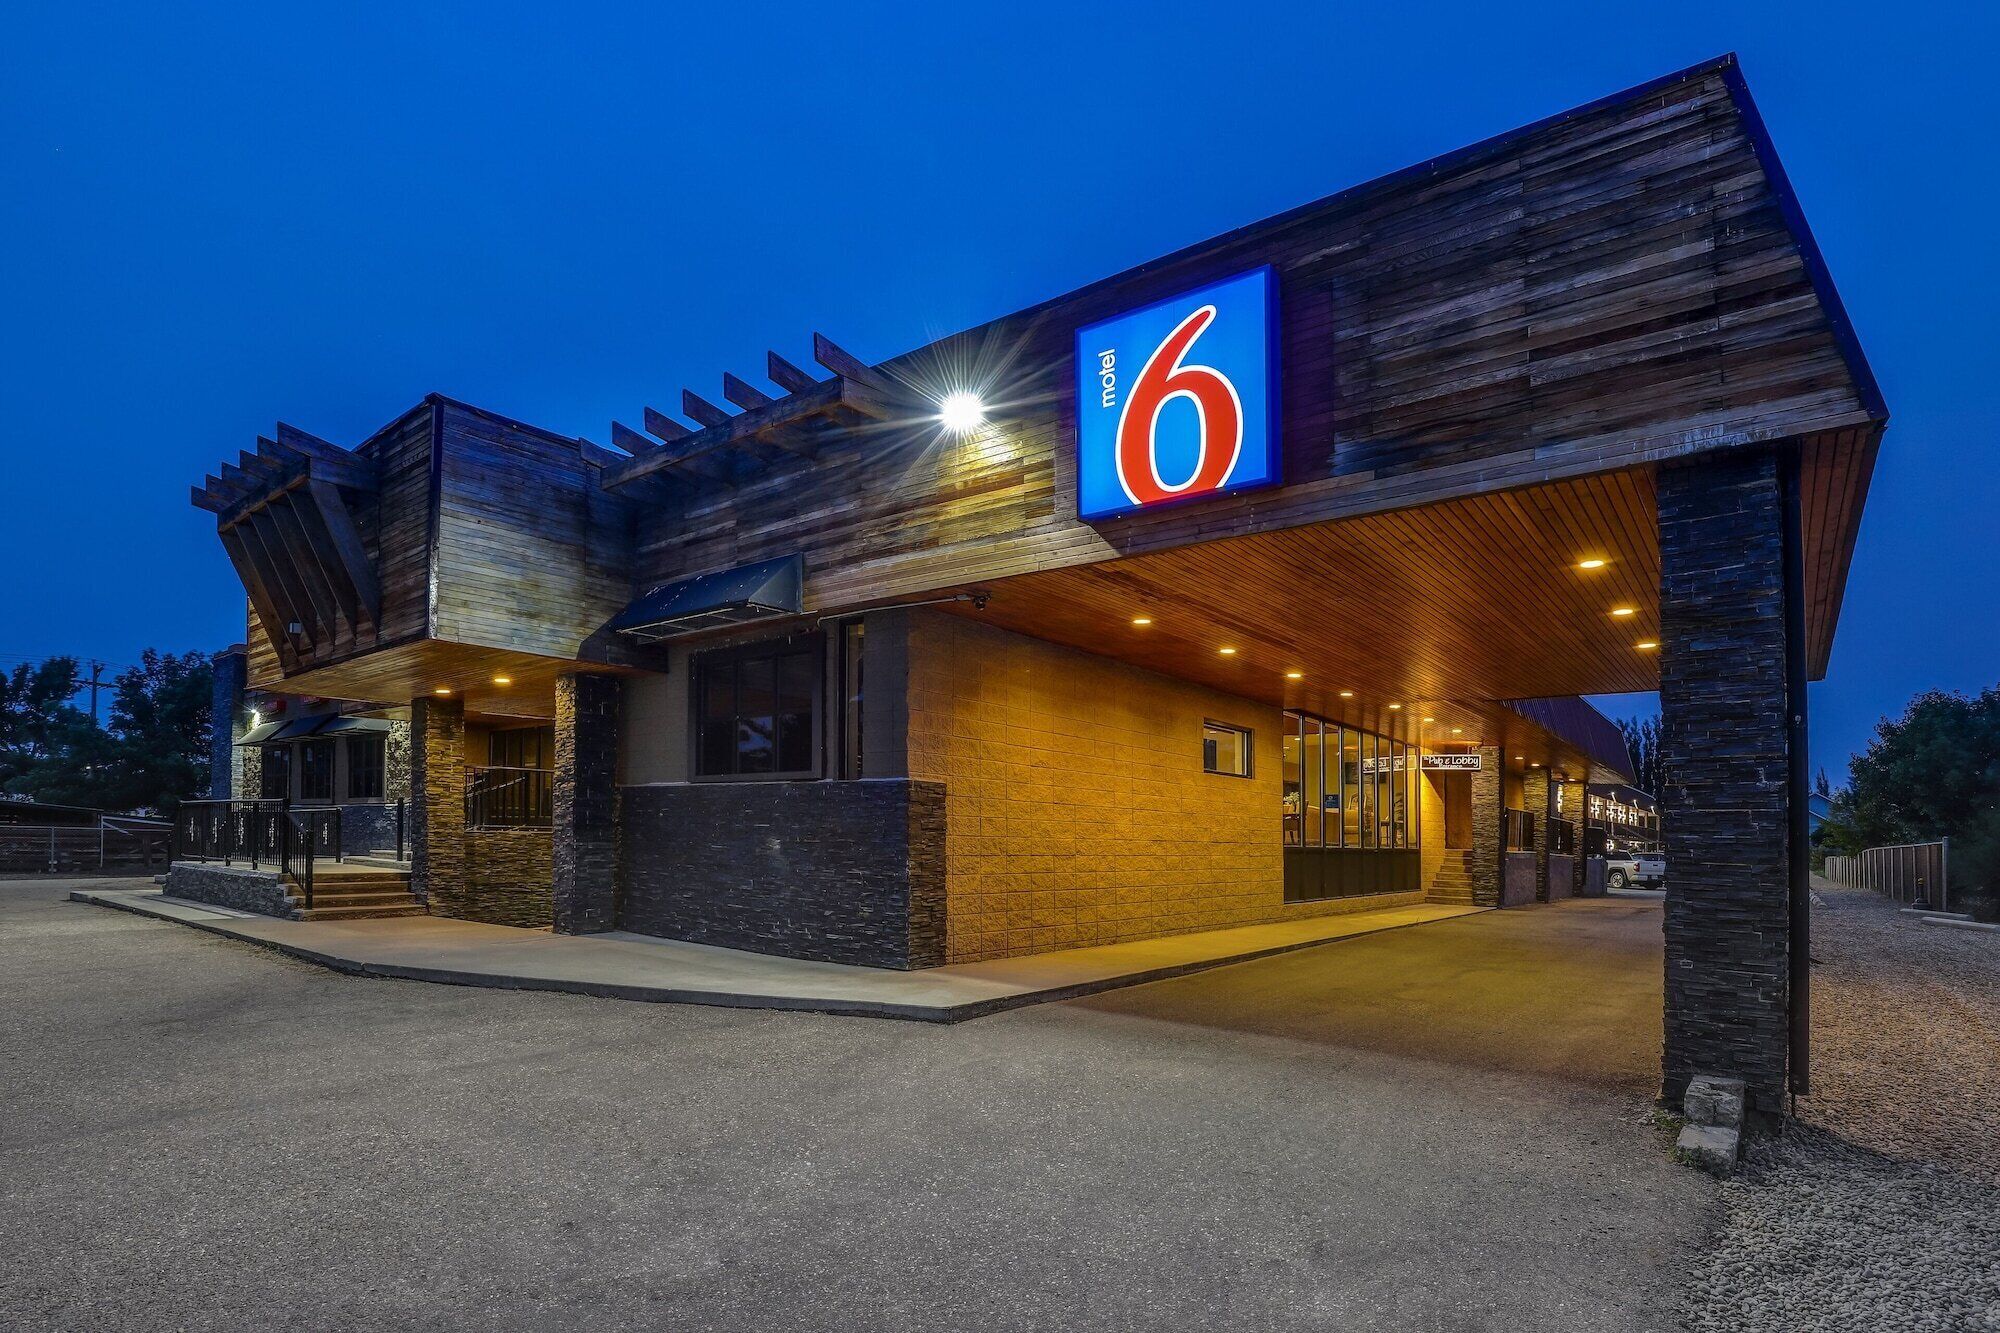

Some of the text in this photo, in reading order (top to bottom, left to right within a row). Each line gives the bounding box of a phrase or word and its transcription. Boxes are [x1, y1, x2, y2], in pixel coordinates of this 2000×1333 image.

[1098, 349, 1116, 408] motel
[1115, 304, 1244, 505] 6
[1429, 756, 1444, 765] Pub
[1452, 756, 1479, 768] Lobby
